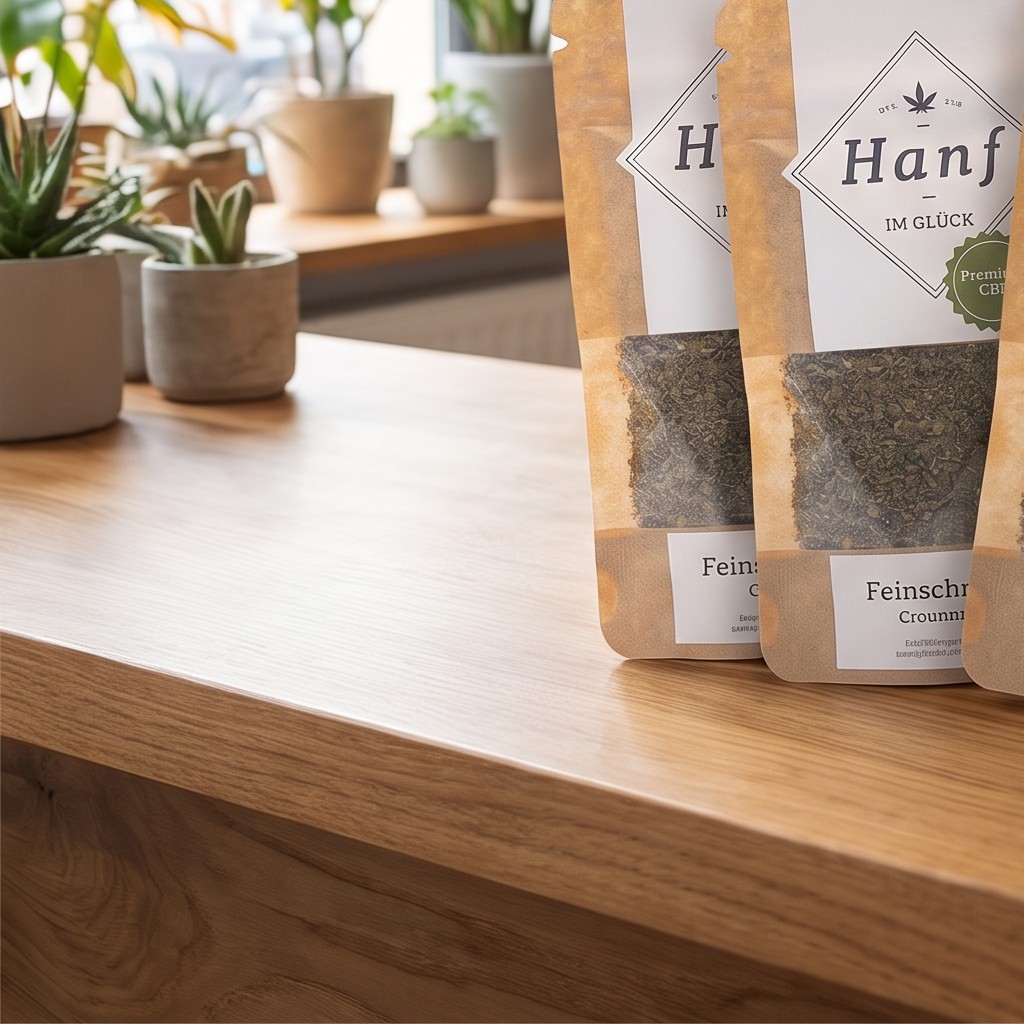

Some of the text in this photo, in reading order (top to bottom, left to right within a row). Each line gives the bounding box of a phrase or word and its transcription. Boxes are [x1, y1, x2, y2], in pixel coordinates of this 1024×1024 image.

[842, 126, 1005, 187] Hanf
[886, 212, 974, 231] IM GLÜCK
